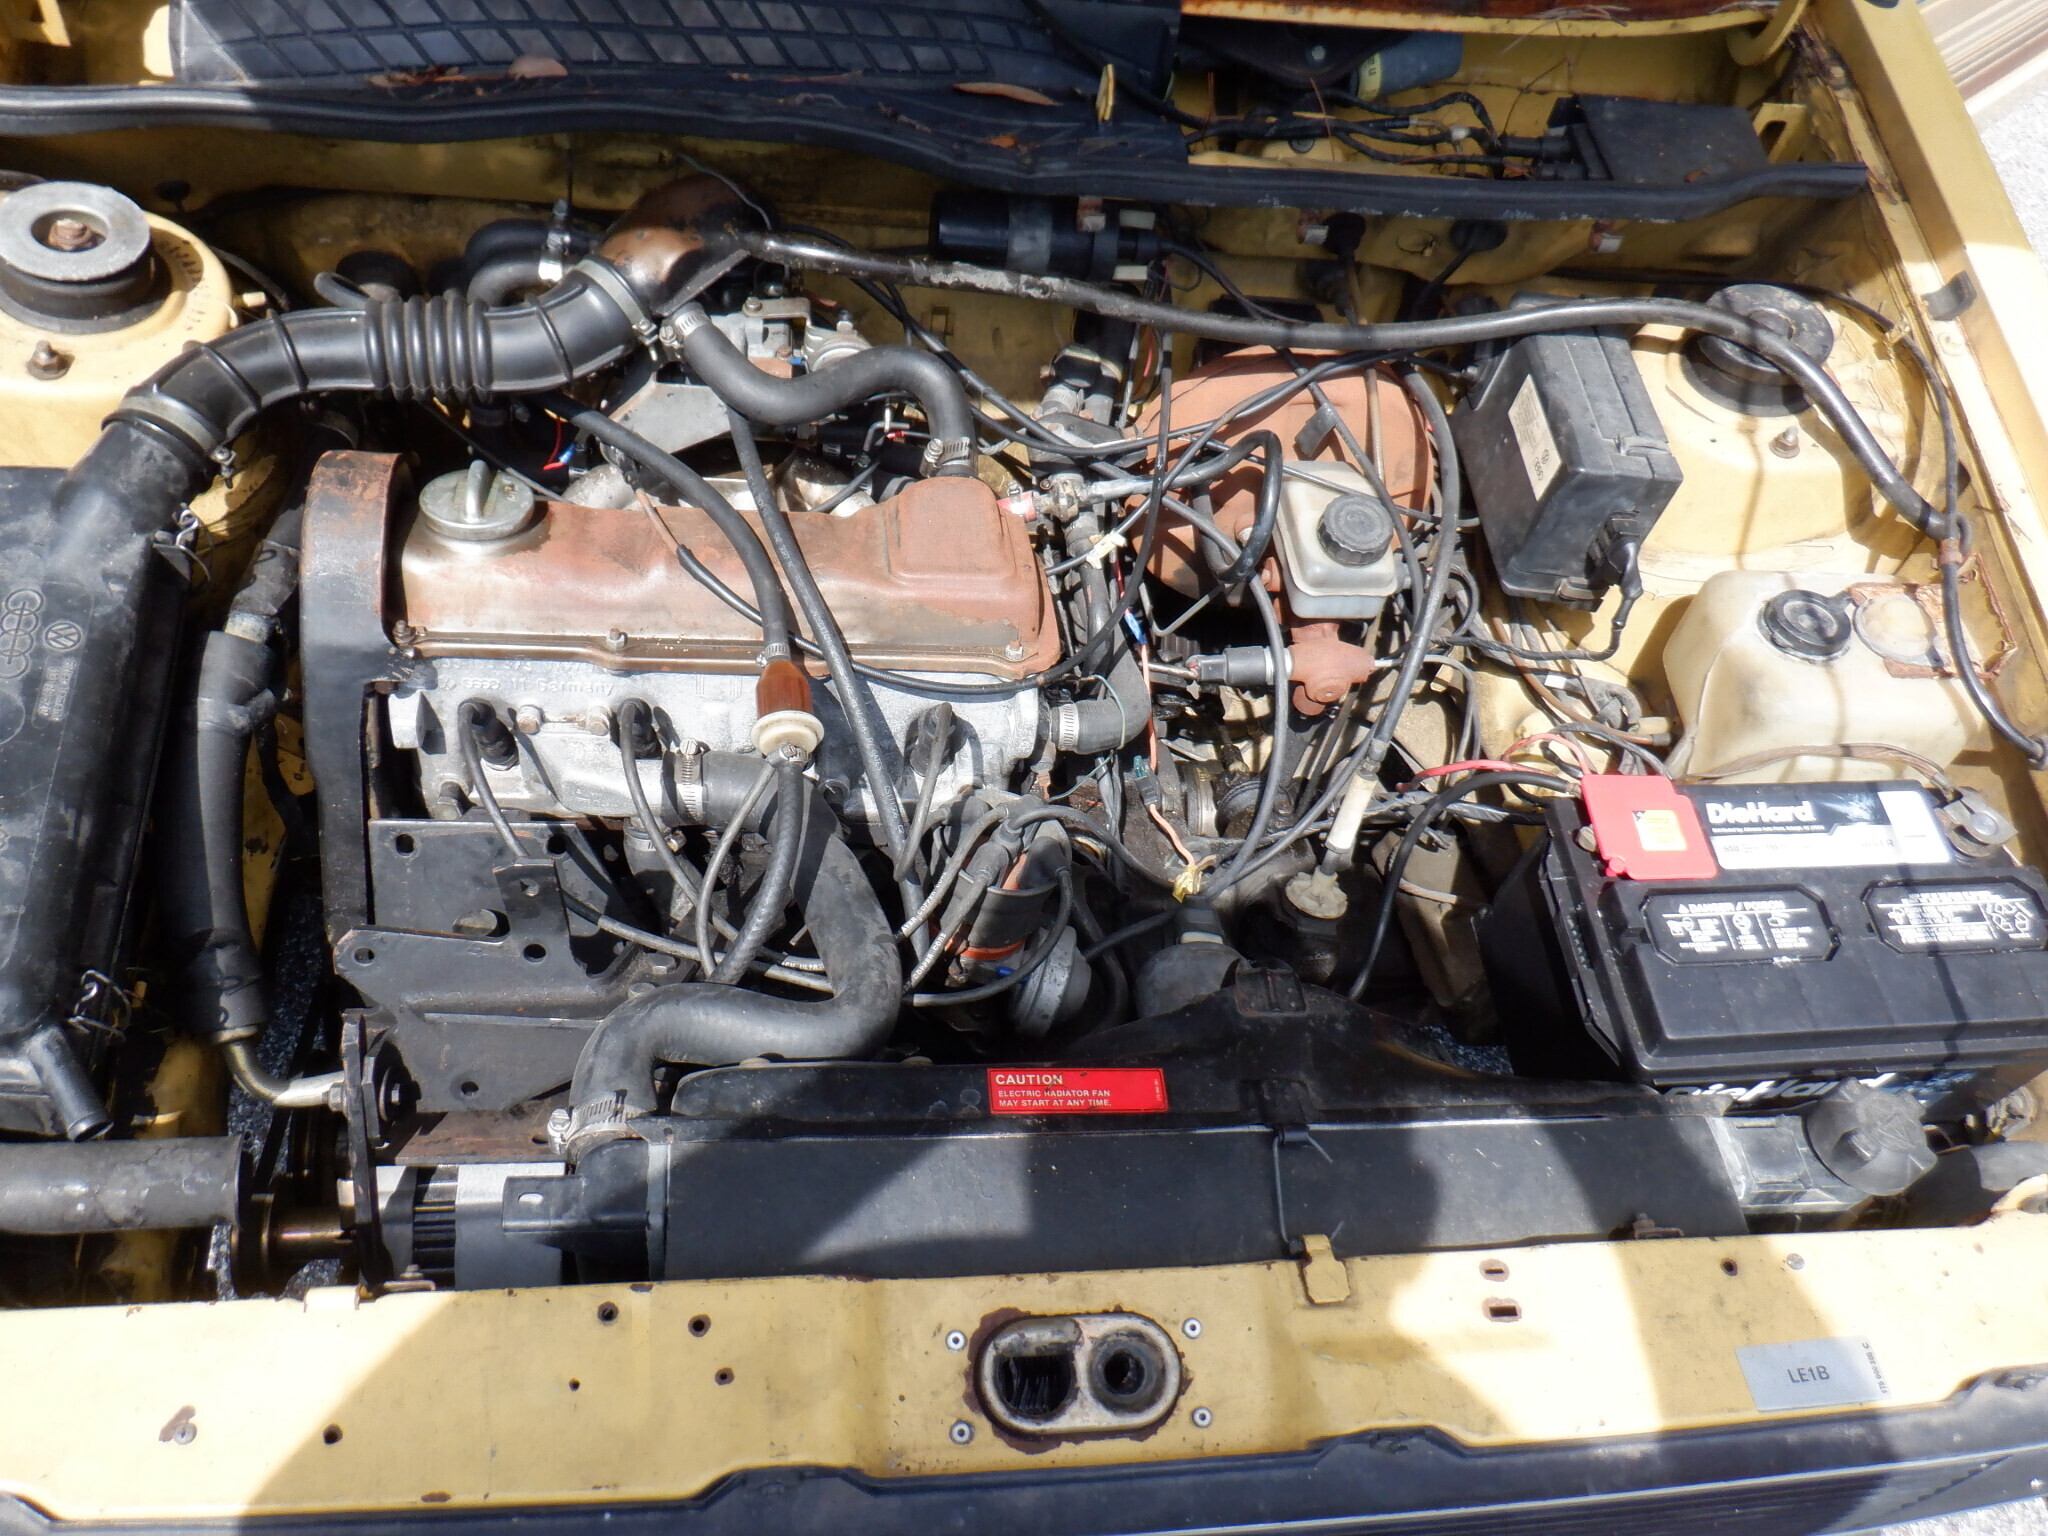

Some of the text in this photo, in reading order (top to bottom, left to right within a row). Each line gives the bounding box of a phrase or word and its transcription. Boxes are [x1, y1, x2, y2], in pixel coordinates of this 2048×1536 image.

[1706, 801, 1816, 823] DieHard
[932, 932, 947, 951] CORE
[995, 1074, 1063, 1085] CAUTION
[1044, 1089, 1089, 1097] RADIATOR
[1092, 1089, 1111, 1097] FAN
[999, 1099, 1112, 1107] MAY START AT ANY TIME.
[1787, 1365, 1830, 1383] LE1B
